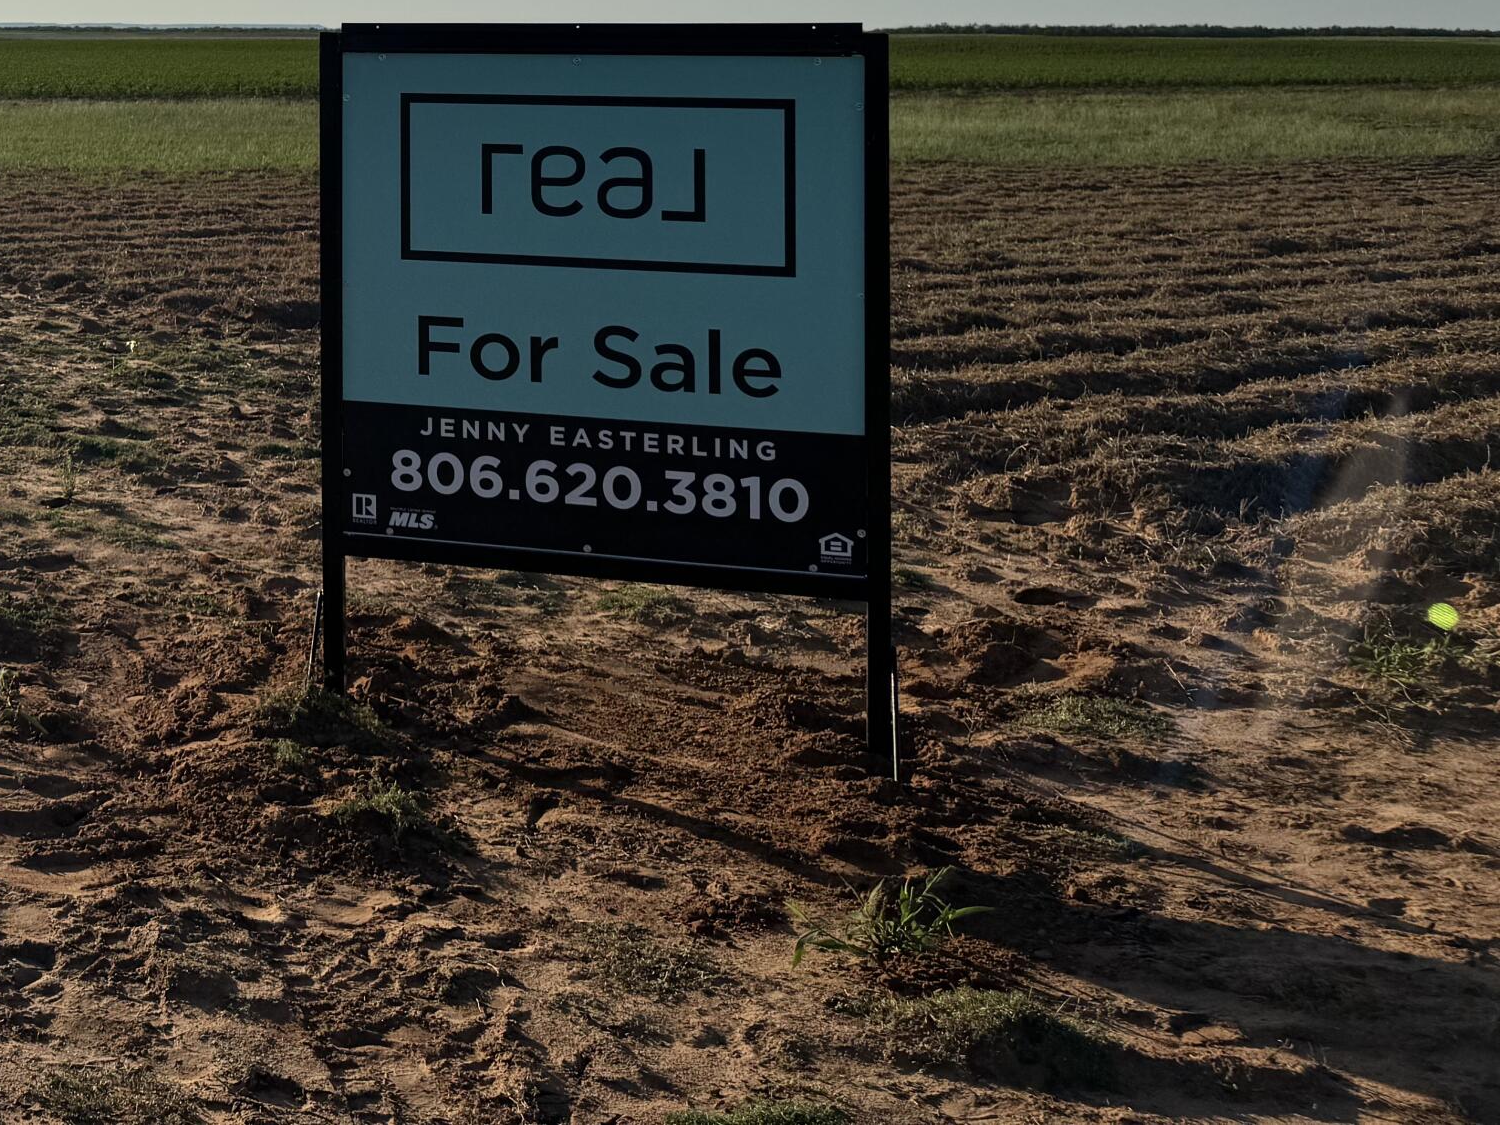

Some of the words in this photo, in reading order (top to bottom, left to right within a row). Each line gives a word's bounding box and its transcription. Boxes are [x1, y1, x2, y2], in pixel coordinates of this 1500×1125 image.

[481, 142, 707, 223] real
[417, 314, 560, 384] For
[591, 324, 783, 399] Sale
[420, 416, 530, 443] JENNY
[550, 426, 777, 462] EASTERLING
[388, 511, 435, 530] MLS
[390, 448, 810, 523] 806.620.3810
